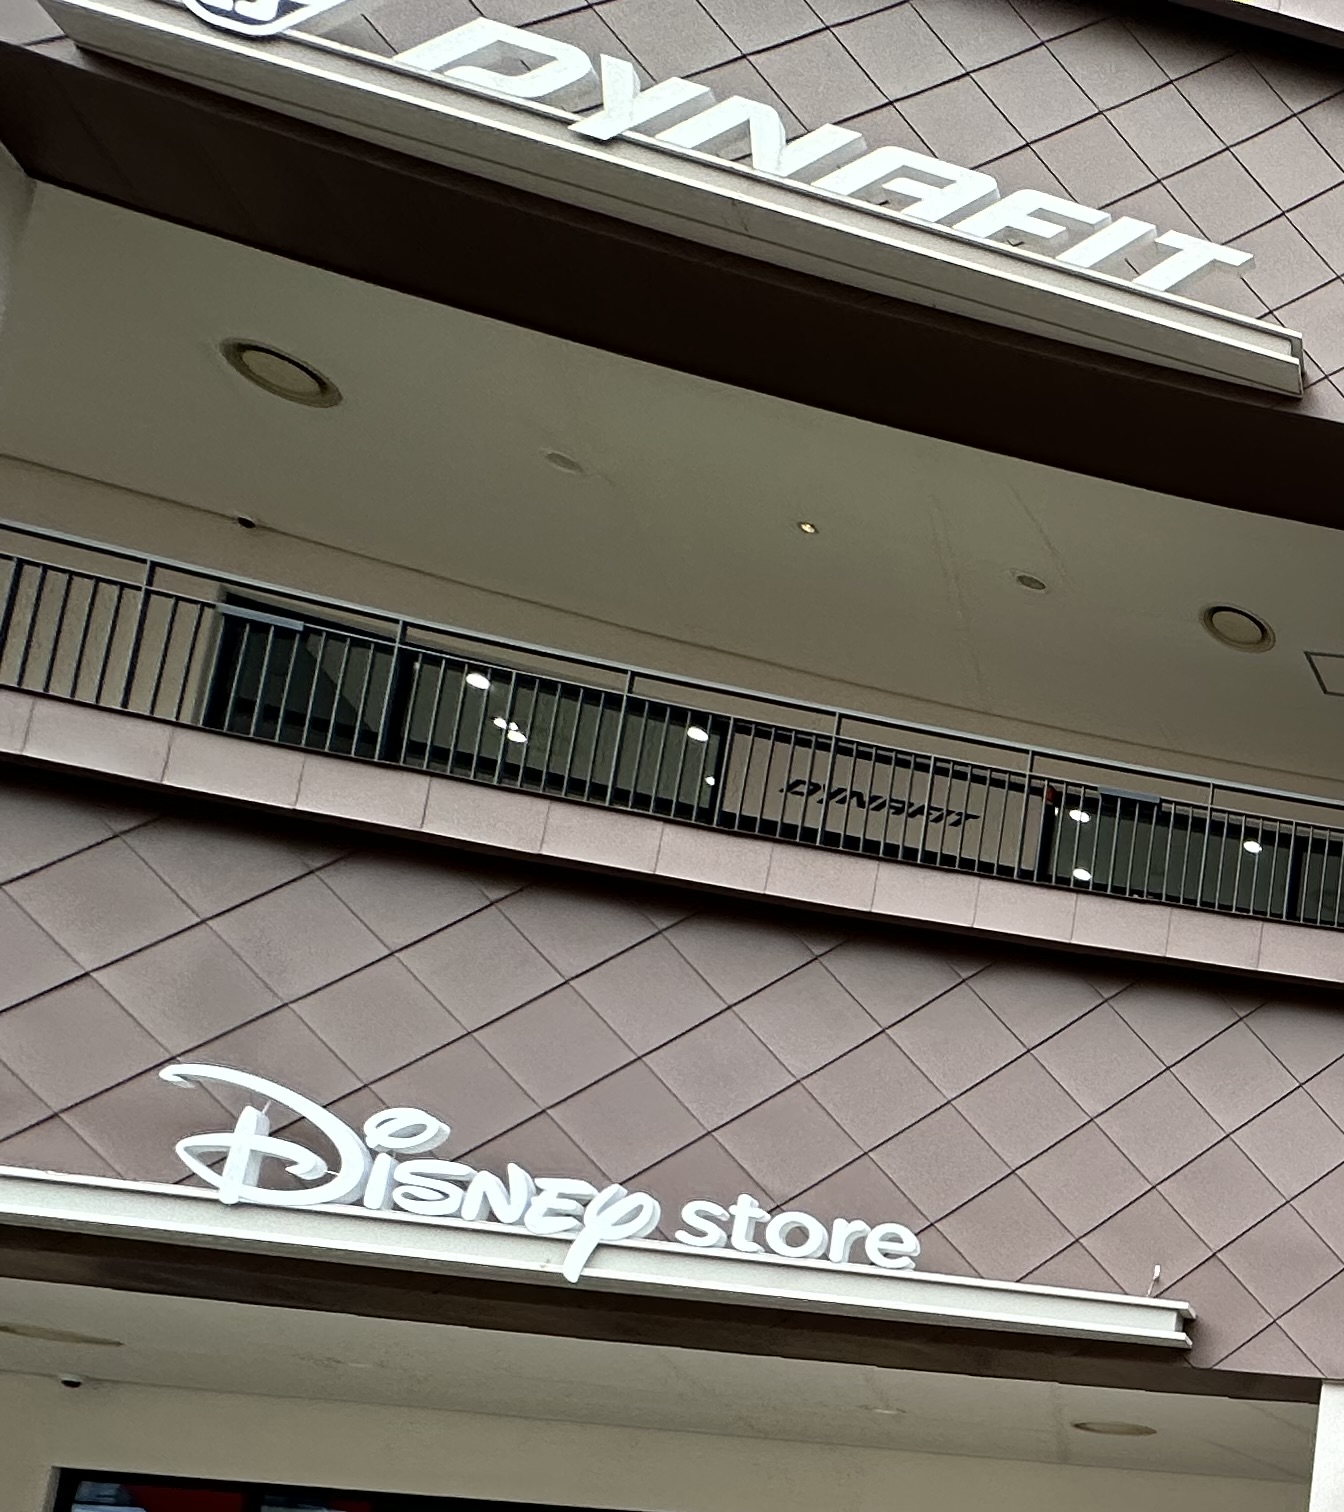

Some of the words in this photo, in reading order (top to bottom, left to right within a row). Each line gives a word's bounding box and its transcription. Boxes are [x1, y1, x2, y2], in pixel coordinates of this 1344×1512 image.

[393, 16, 1254, 291] DYNAFIT
[778, 778, 981, 828] DYNAFIT
[157, 1061, 661, 1284] Disney
[674, 1191, 922, 1271] store
